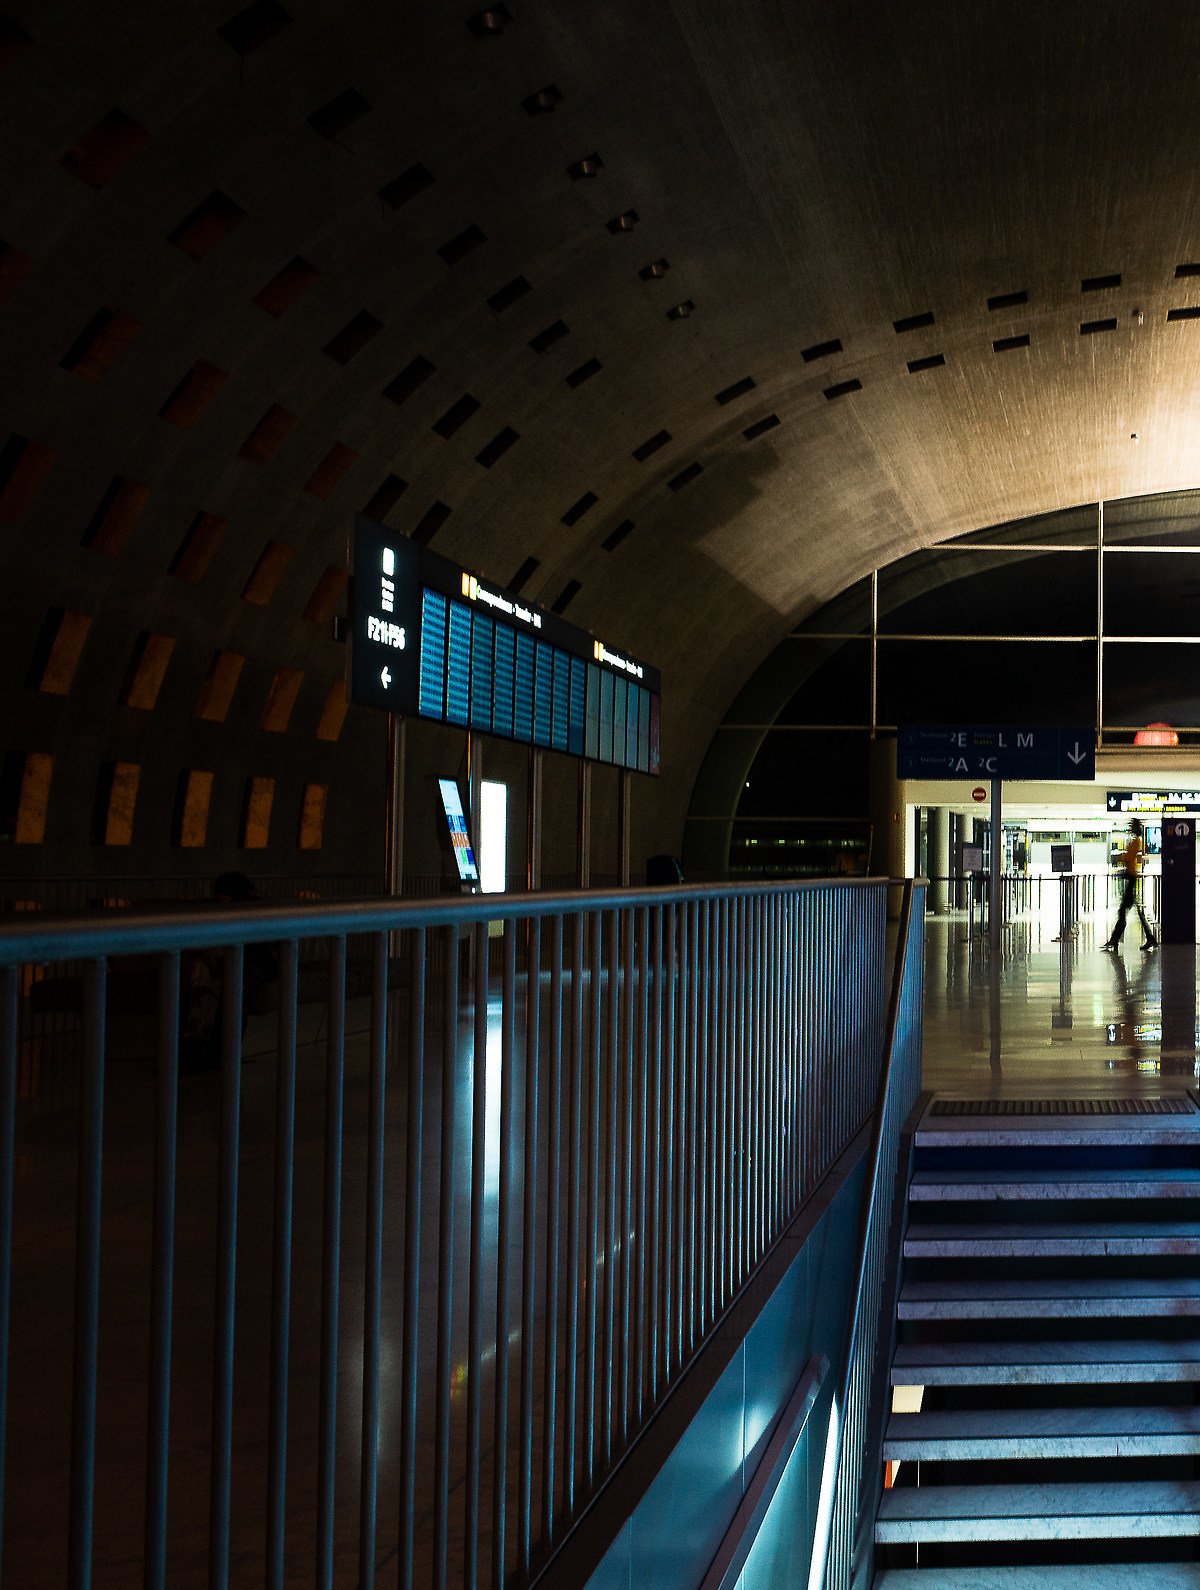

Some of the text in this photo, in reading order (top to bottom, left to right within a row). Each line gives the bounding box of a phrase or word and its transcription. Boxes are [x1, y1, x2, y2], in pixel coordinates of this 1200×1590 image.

[950, 732, 967, 748] 2E
[998, 732, 1007, 748] L
[1017, 732, 1034, 748] M
[948, 757, 969, 772] 2A
[978, 757, 998, 773] 2C
